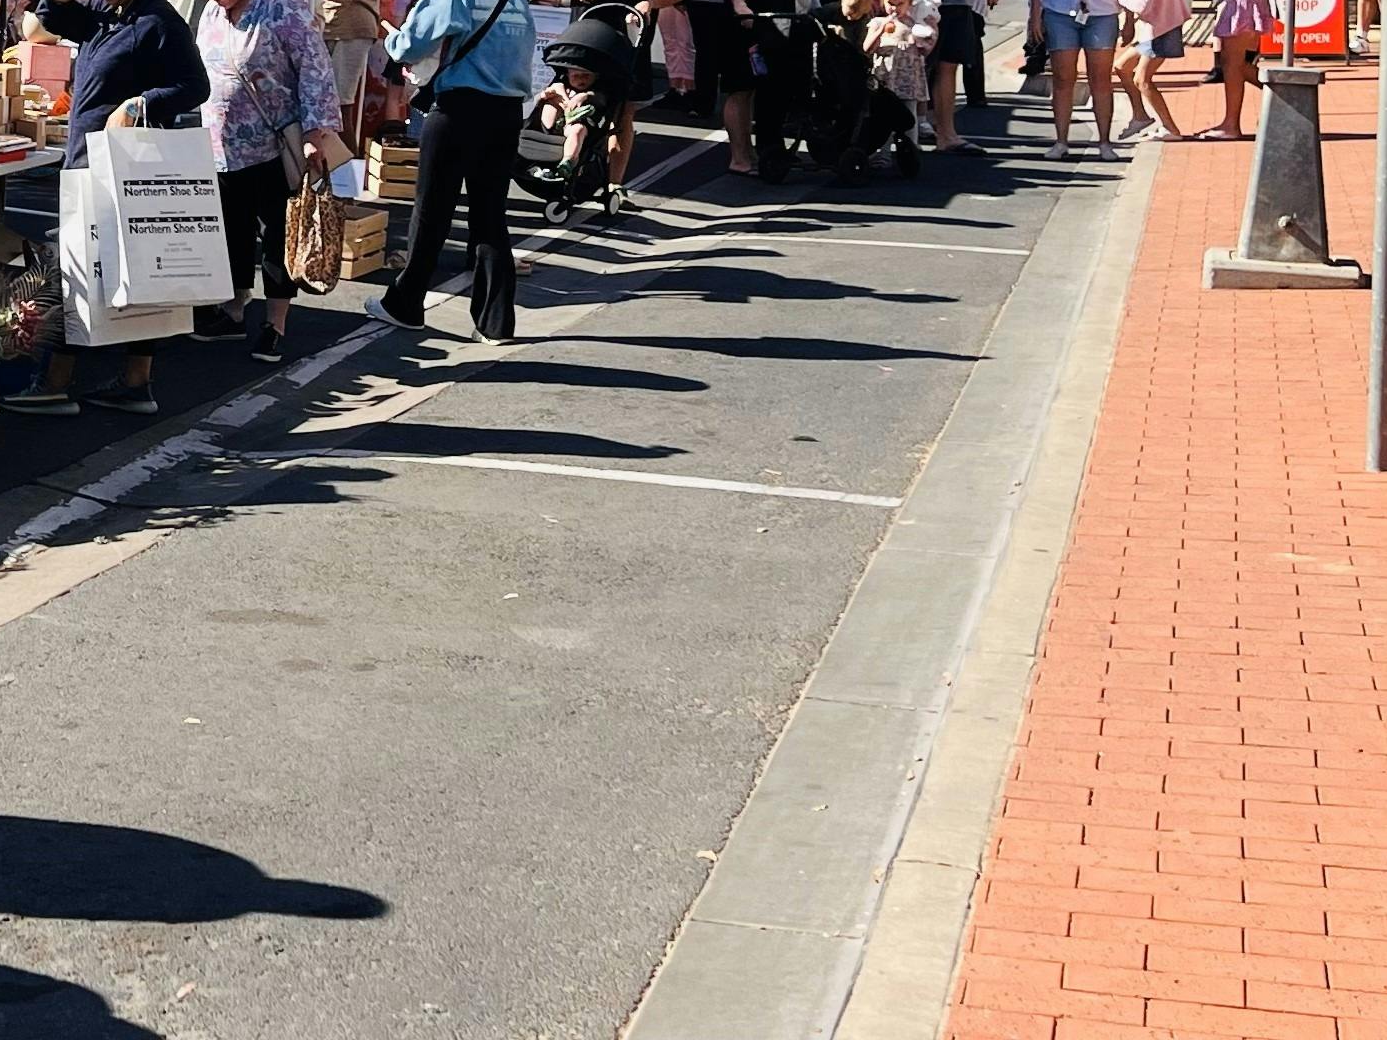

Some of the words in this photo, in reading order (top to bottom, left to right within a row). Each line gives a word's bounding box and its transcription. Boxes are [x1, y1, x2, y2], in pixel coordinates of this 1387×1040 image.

[1300, 33, 1331, 44] OPEN
[124, 187, 167, 196] Northern
[170, 186, 191, 196] Shoe
[193, 186, 215, 196] Store
[129, 224, 171, 234] Northern
[174, 224, 195, 233] Shoe
[197, 223, 219, 233] Store
